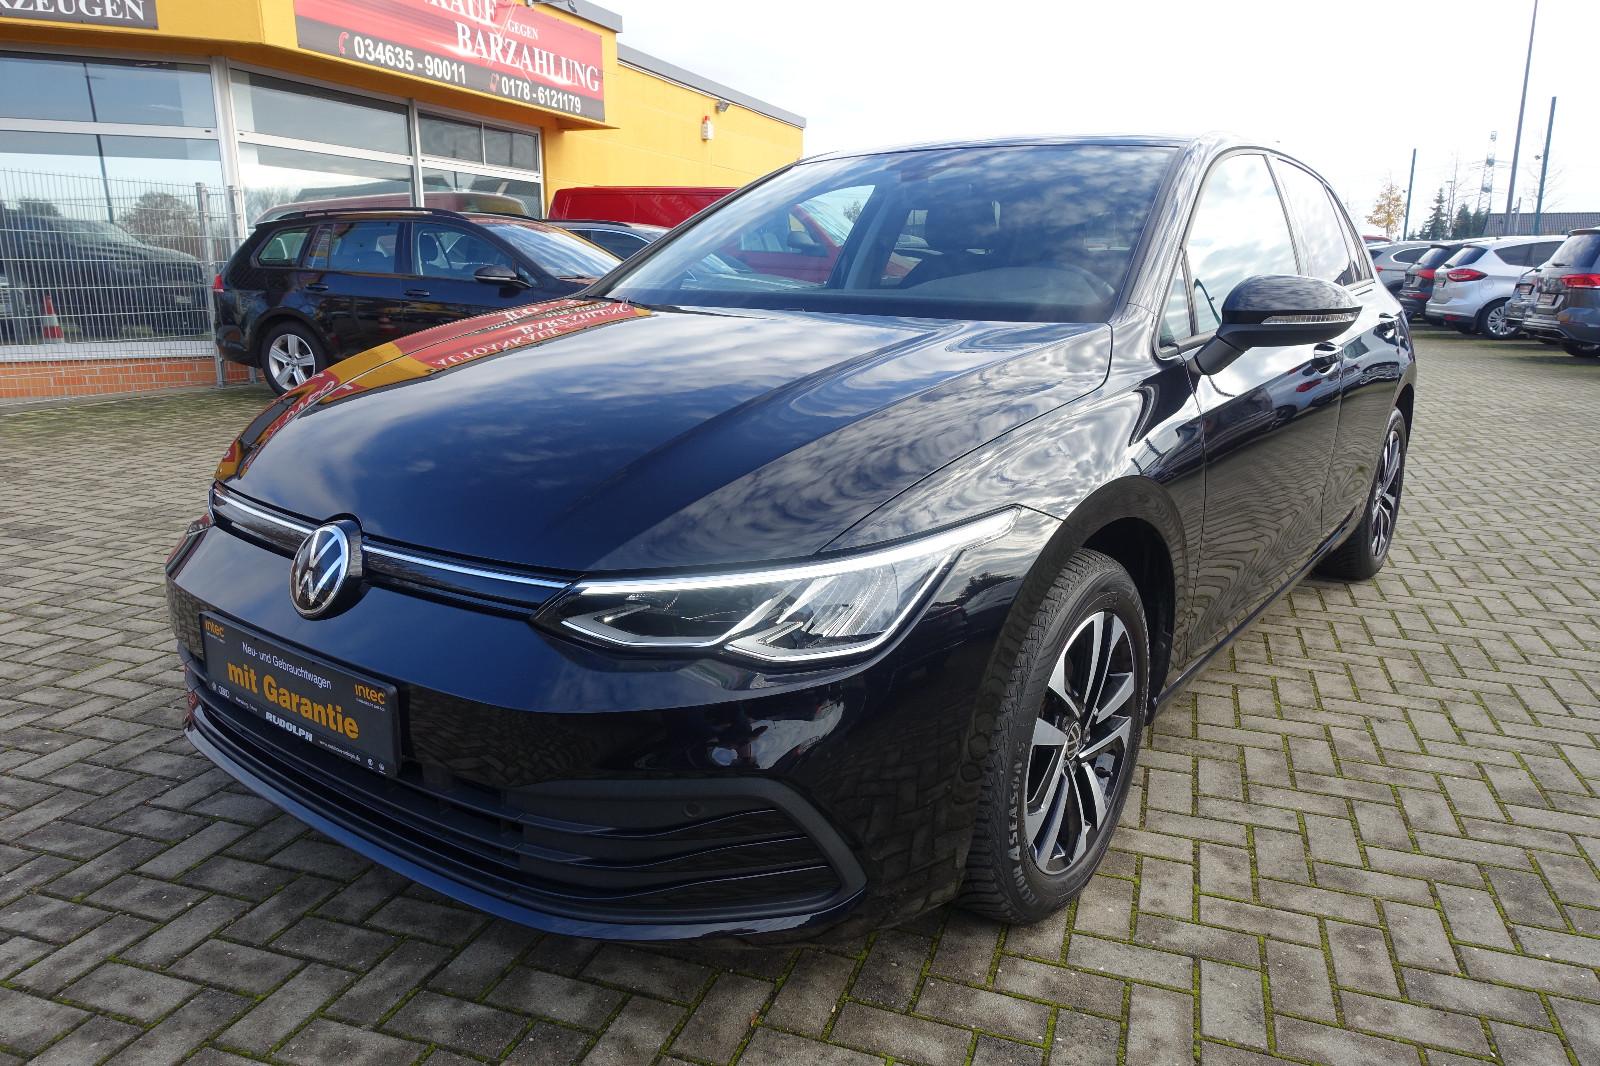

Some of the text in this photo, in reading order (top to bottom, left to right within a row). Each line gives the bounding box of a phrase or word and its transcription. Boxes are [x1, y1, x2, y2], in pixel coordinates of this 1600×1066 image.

[424, 0, 497, 24] AUF
[507, 19, 539, 41] GEGEN
[454, 21, 599, 92] BARZAHLUNG
[258, 651, 271, 665] und
[272, 655, 332, 690] Gebrauchtwagen
[227, 662, 360, 739] mit Garantie
[354, 683, 386, 705] intec
[265, 711, 313, 742] RUDOLPH
